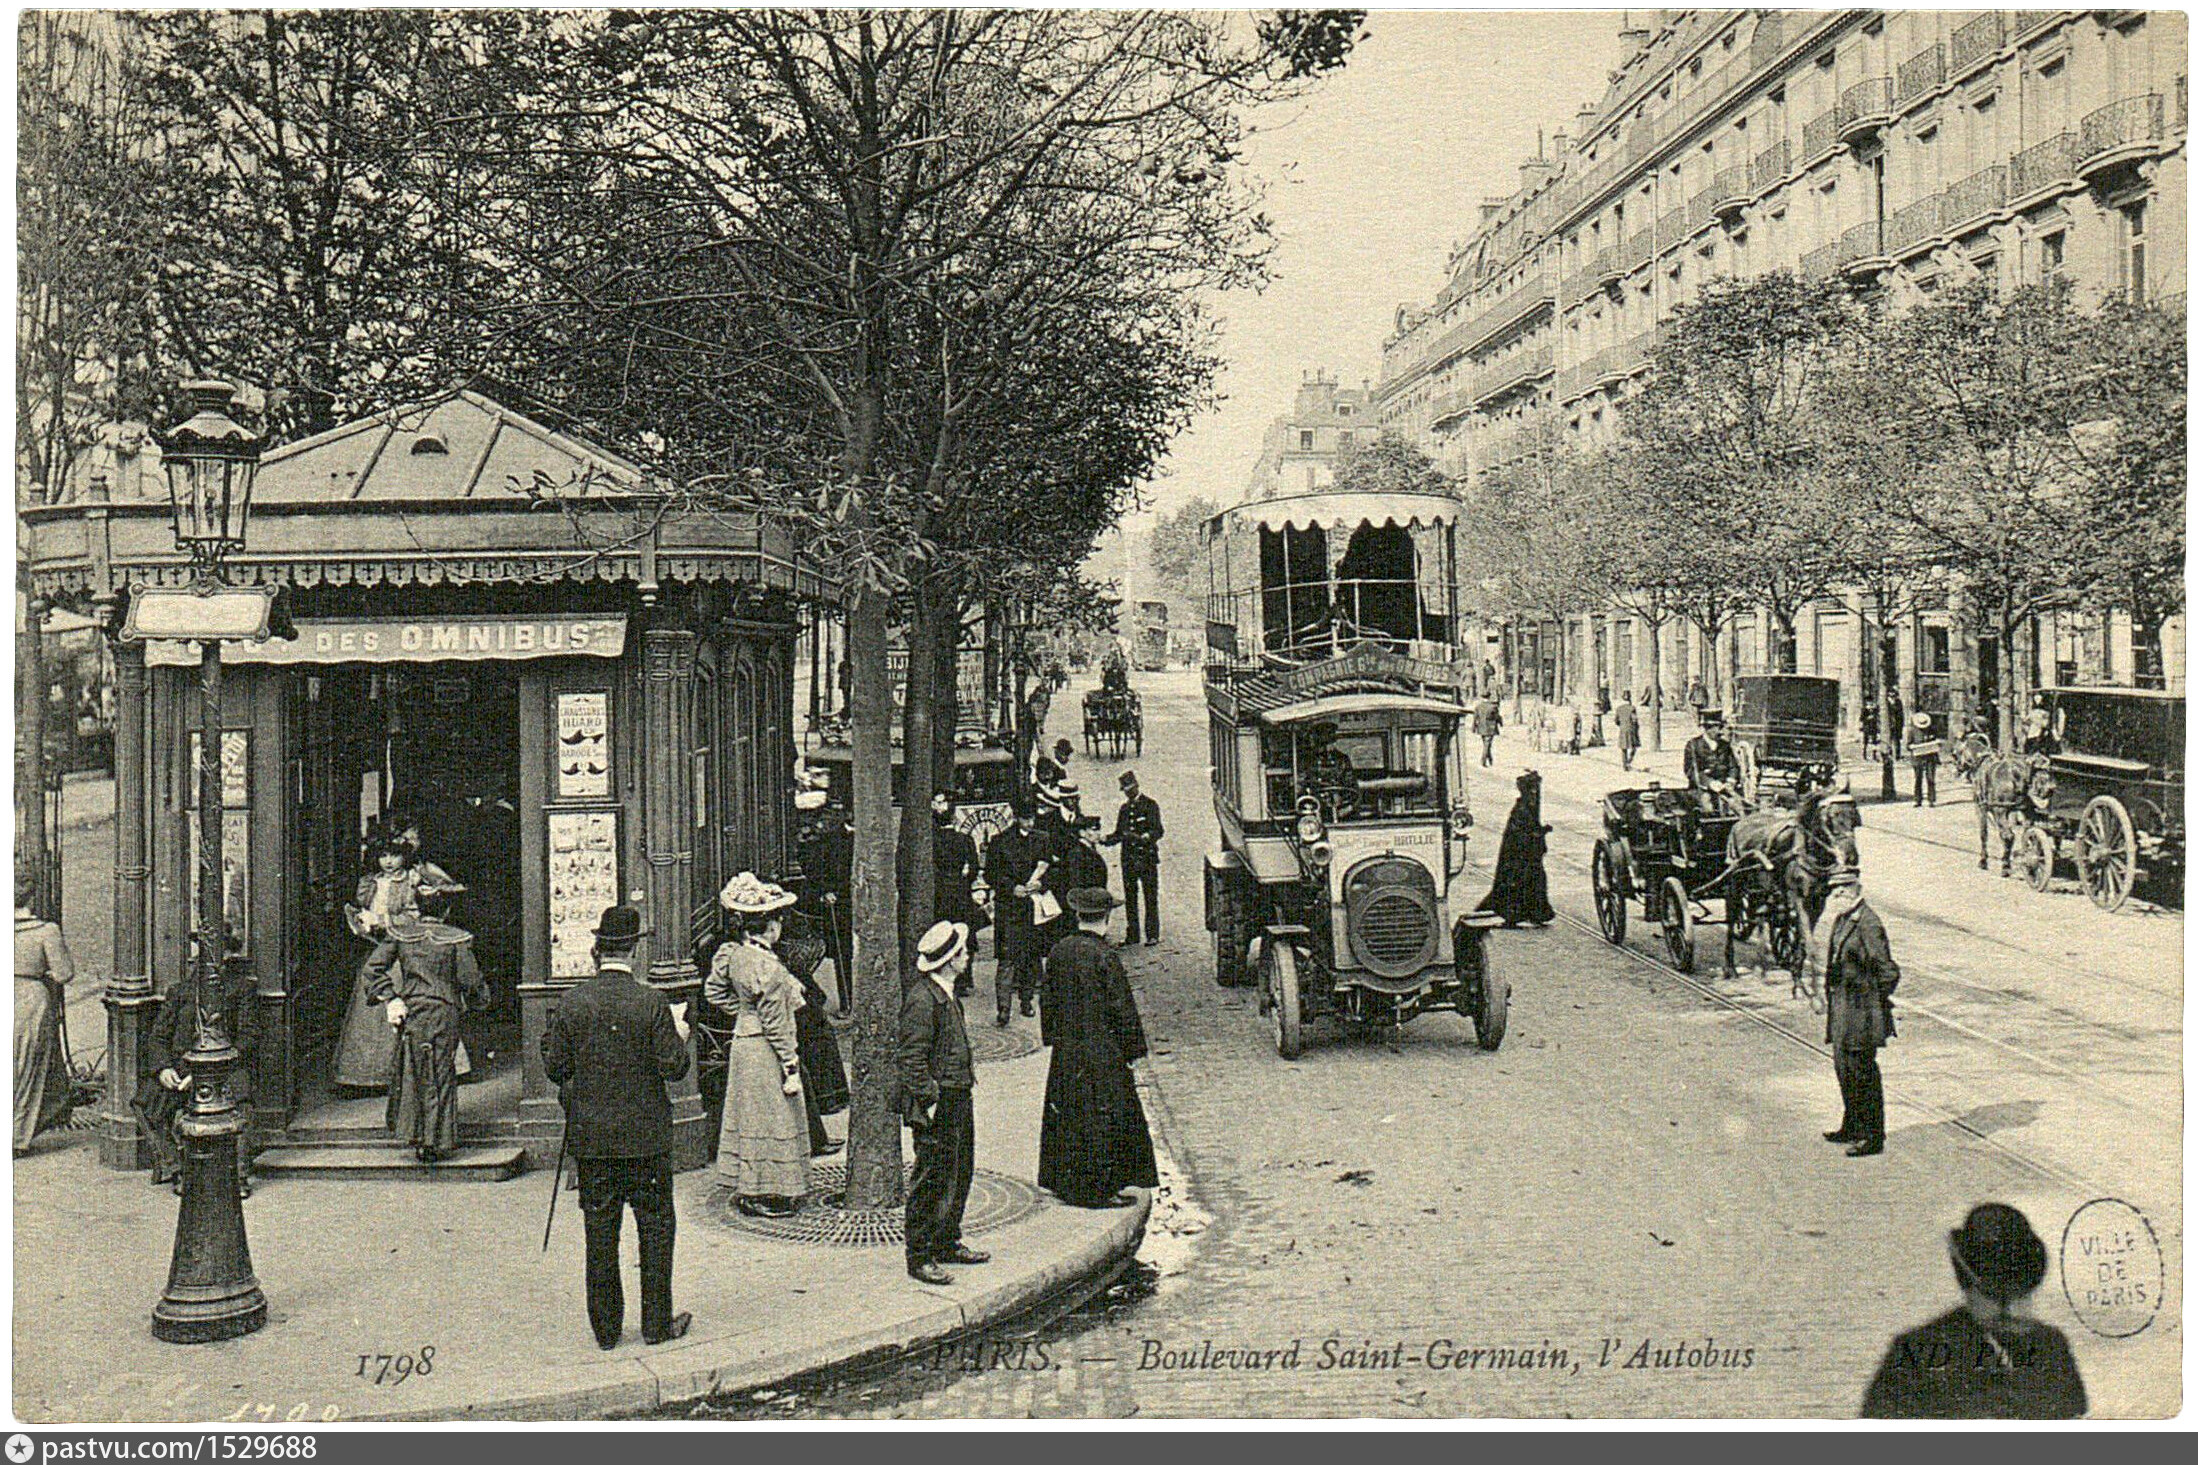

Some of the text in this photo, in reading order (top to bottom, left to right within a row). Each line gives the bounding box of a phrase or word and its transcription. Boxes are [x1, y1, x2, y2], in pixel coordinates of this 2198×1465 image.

[316, 622, 591, 652] DES OMNIBUS
[1288, 658, 1356, 690] COMPAGNIE
[1395, 658, 1451, 681] OMNIBUS
[562, 717, 602, 728] HUARD
